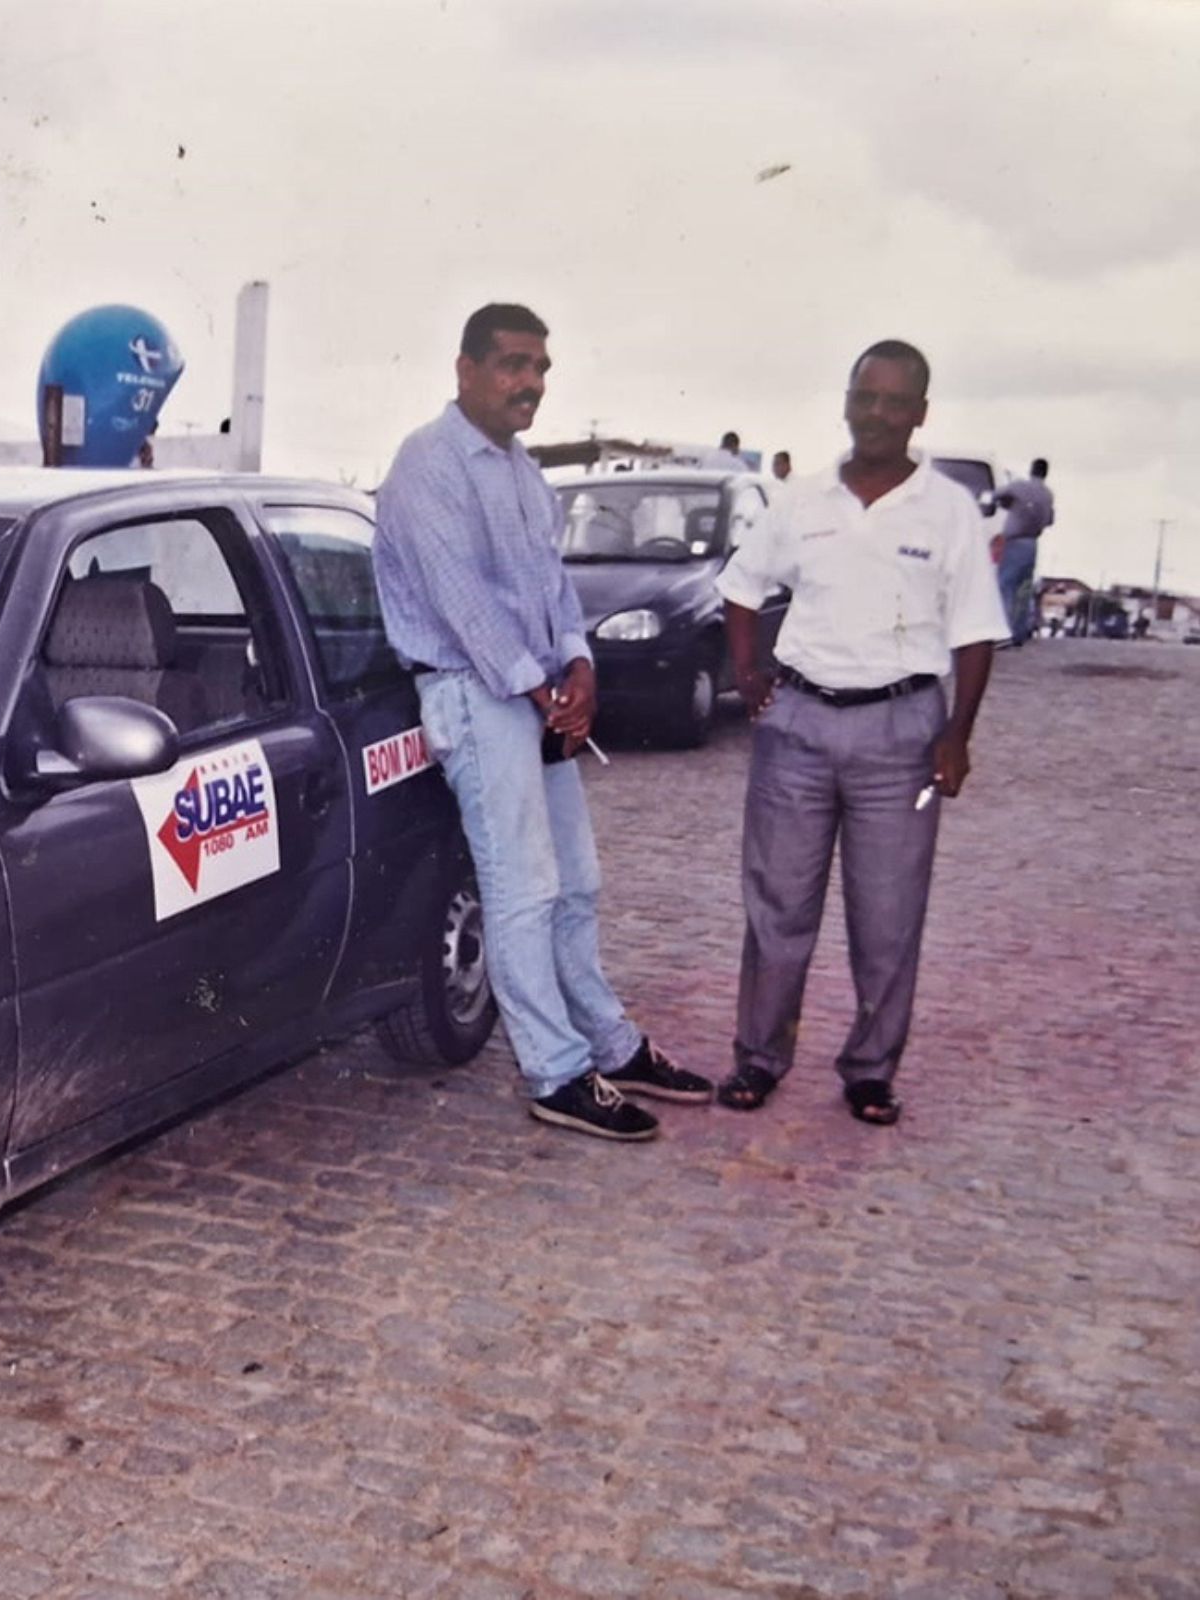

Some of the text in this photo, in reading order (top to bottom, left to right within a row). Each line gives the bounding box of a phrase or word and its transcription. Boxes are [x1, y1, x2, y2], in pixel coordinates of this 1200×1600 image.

[367, 740, 402, 787] BOM
[203, 821, 269, 857] 1080 AM
